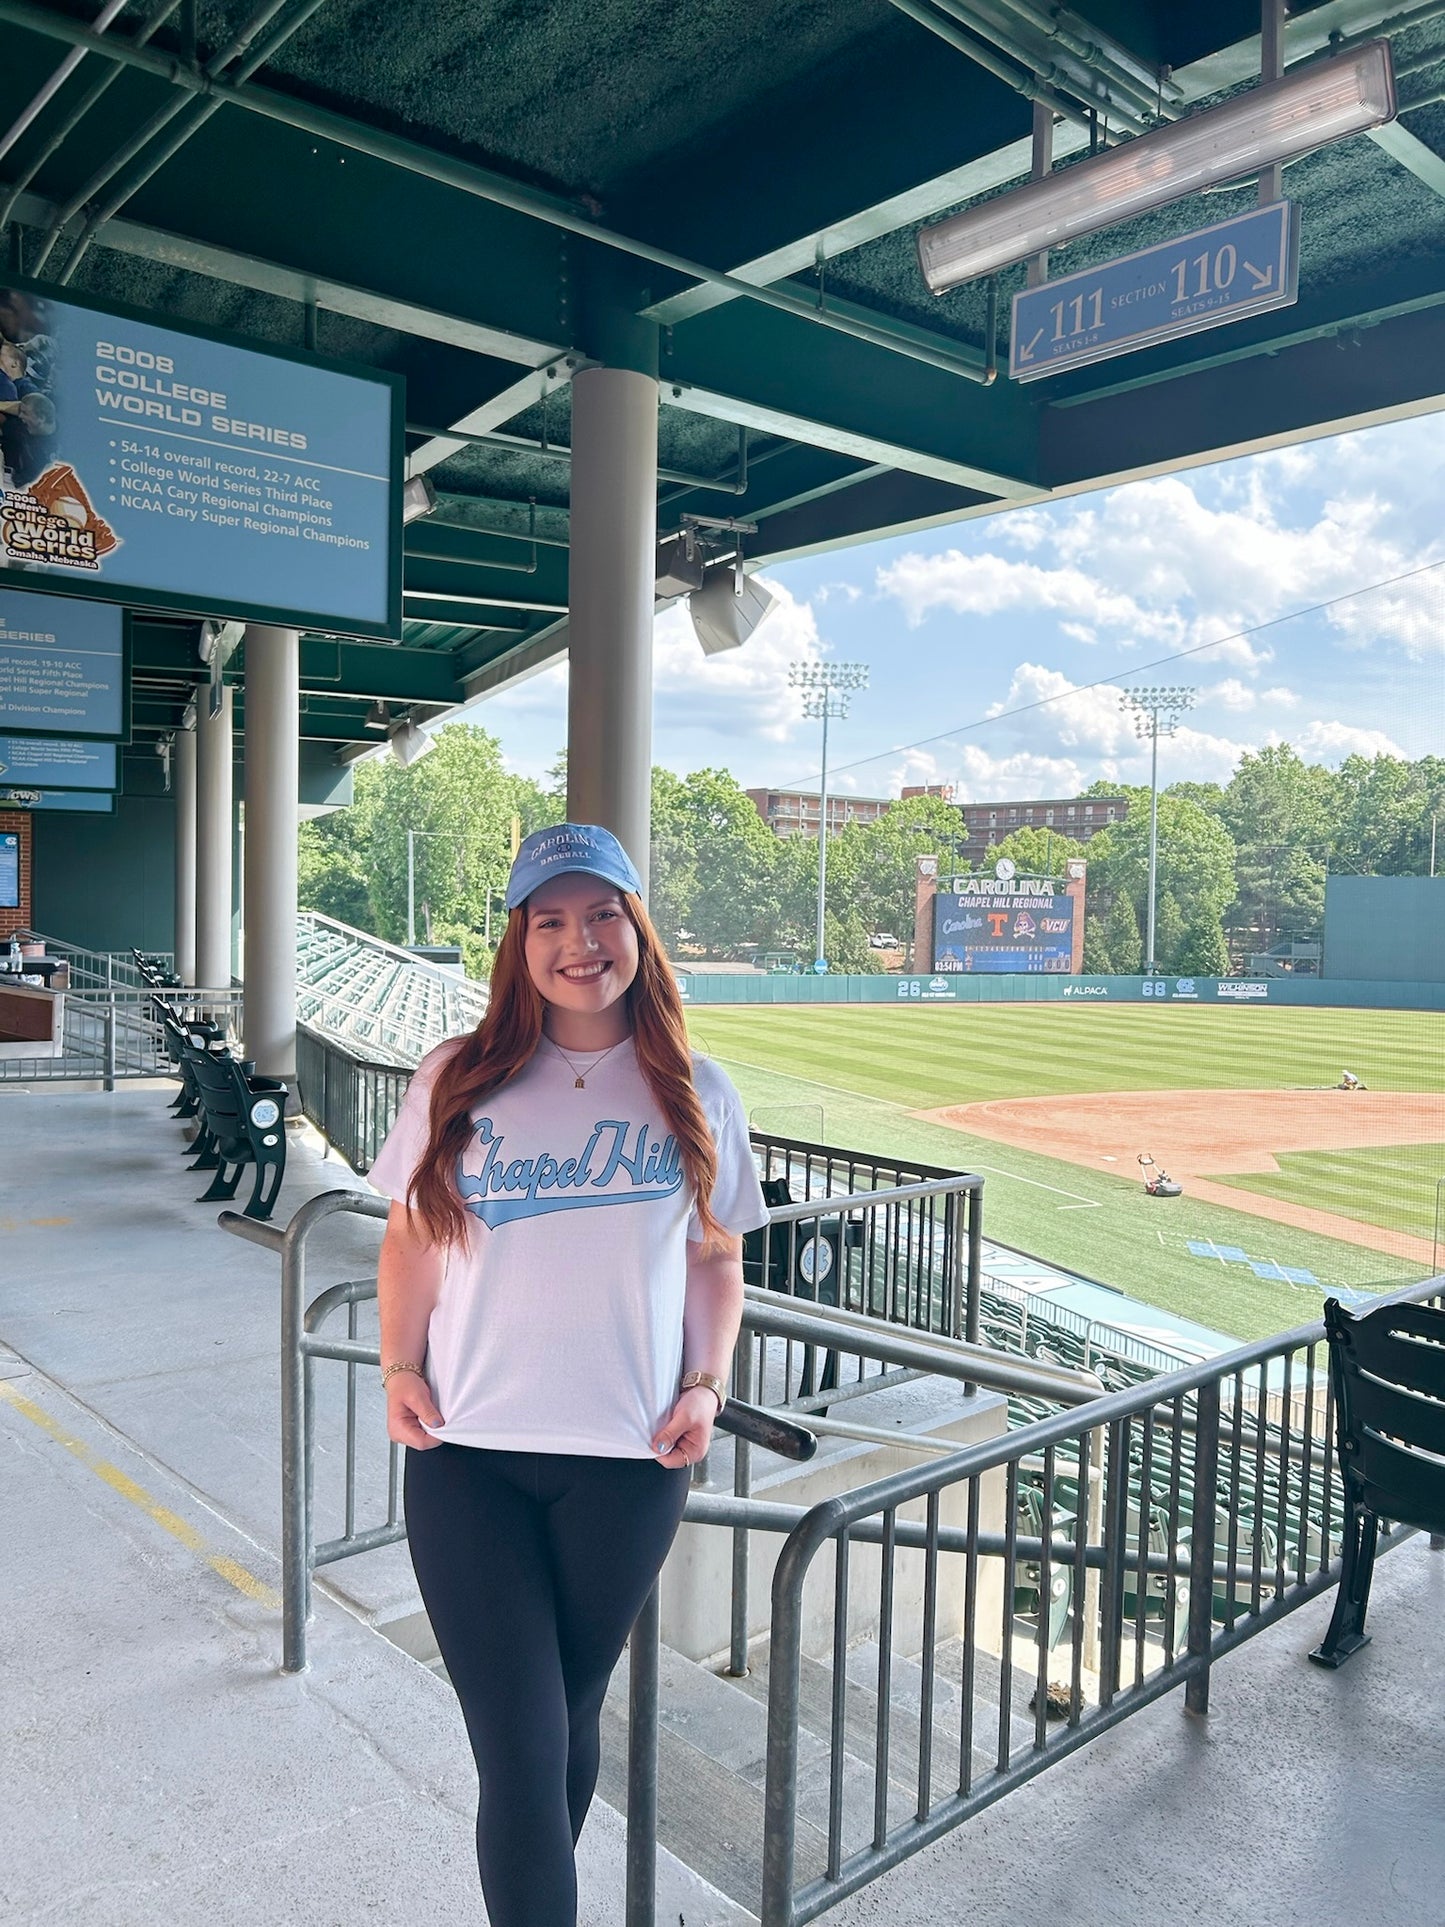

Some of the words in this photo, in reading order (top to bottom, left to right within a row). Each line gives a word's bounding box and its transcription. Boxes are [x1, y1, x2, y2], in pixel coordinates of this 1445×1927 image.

[1171, 244, 1237, 304] 110
[1111, 281, 1167, 309] SECTION
[1050, 288, 1106, 342] 111
[1171, 302, 1205, 319] SEATS
[1053, 340, 1082, 355] SEATS
[1085, 333, 1098, 345] 1-8
[96, 341, 174, 374] 2008
[96, 365, 227, 410] COLLEGE
[95, 388, 202, 427] WORLD
[211, 415, 308, 450] SERIES
[121, 440, 160, 459] 54-14
[163, 451, 211, 470] overall
[215, 461, 260, 481] record,
[263, 469, 291, 485] 22-7
[294, 476, 321, 491] ACC
[121, 458, 174, 480] College
[177, 469, 219, 489] World
[223, 479, 262, 497] Series
[265, 486, 298, 503] Third
[301, 494, 333, 511] Place
[6, 492, 37, 505] 2008
[14, 501, 47, 514] Men's
[121, 476, 163, 495] NCAA
[167, 485, 198, 504] Cary
[202, 491, 259, 513] Regional
[263, 503, 332, 527] Champions
[1, 507, 67, 529] College
[121, 494, 163, 513] NCAA
[167, 503, 198, 522] Cary
[202, 509, 240, 527] Super
[243, 517, 300, 537] Regional
[303, 527, 370, 550] Champions
[14, 520, 94, 547] World
[11, 532, 96, 560] Series
[7, 547, 47, 562] Omaha,
[49, 555, 98, 569] Nebraska
[17, 668, 40, 676] Series
[42, 669, 60, 677] Fifth
[62, 670, 83, 679] Place
[65, 662, 82, 670] ACC
[14, 685, 27, 693] Hill
[29, 686, 52, 696] Super
[54, 689, 89, 698] Regional
[29, 678, 64, 687] Regional
[65, 680, 109, 690] Champions
[8, 703, 40, 712] Division
[42, 705, 86, 715] Champions
[531, 833, 601, 861] CAROLINA
[540, 851, 591, 866] BASEBALL
[953, 878, 1055, 896] CAROLINA
[958, 896, 991, 908] CHAPEL
[993, 897, 1011, 908] HILL
[1012, 898, 1053, 909] REGIONAL
[943, 914, 983, 935] Carolina
[987, 913, 1008, 937] T
[1046, 918, 1069, 932] VCU
[897, 980, 920, 997] 26
[1073, 986, 1107, 995] ALPACA
[1142, 981, 1166, 997] 68
[456, 1117, 598, 1200] Chapel
[591, 1119, 684, 1187] Hill
